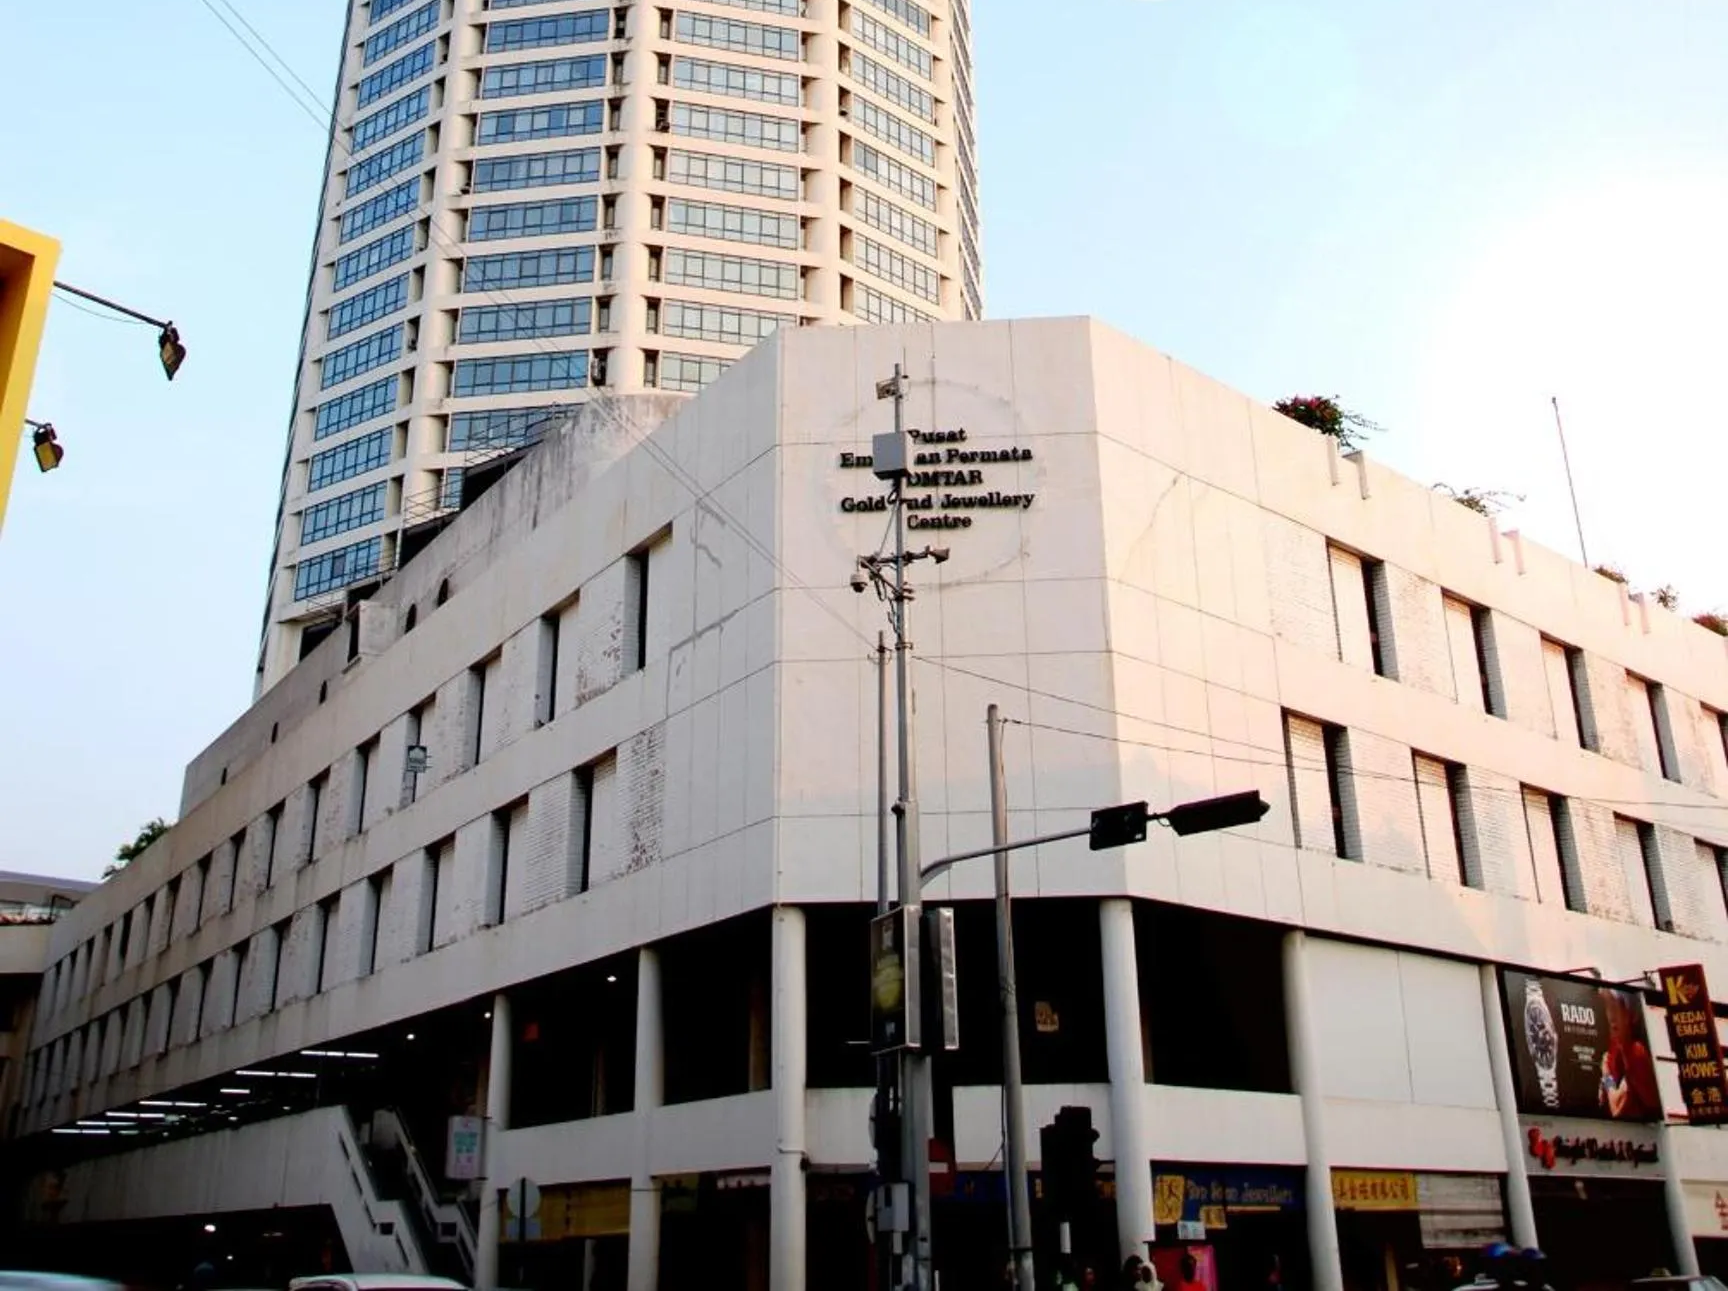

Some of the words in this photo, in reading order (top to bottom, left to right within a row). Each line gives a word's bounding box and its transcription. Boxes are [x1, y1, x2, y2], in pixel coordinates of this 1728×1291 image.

[906, 427, 967, 444] Pusat
[945, 446, 1033, 464] Permata
[906, 469, 983, 487] OMTAR
[841, 496, 887, 512] Gold
[941, 491, 1035, 510] Jewellery
[907, 514, 972, 530] Centre
[1560, 1002, 1596, 1026] RADO
[1672, 1010, 1706, 1023] KEDAI
[1677, 1022, 1708, 1037] EMAS
[1683, 1041, 1708, 1060] KIM
[1682, 1060, 1720, 1079] HOWE
